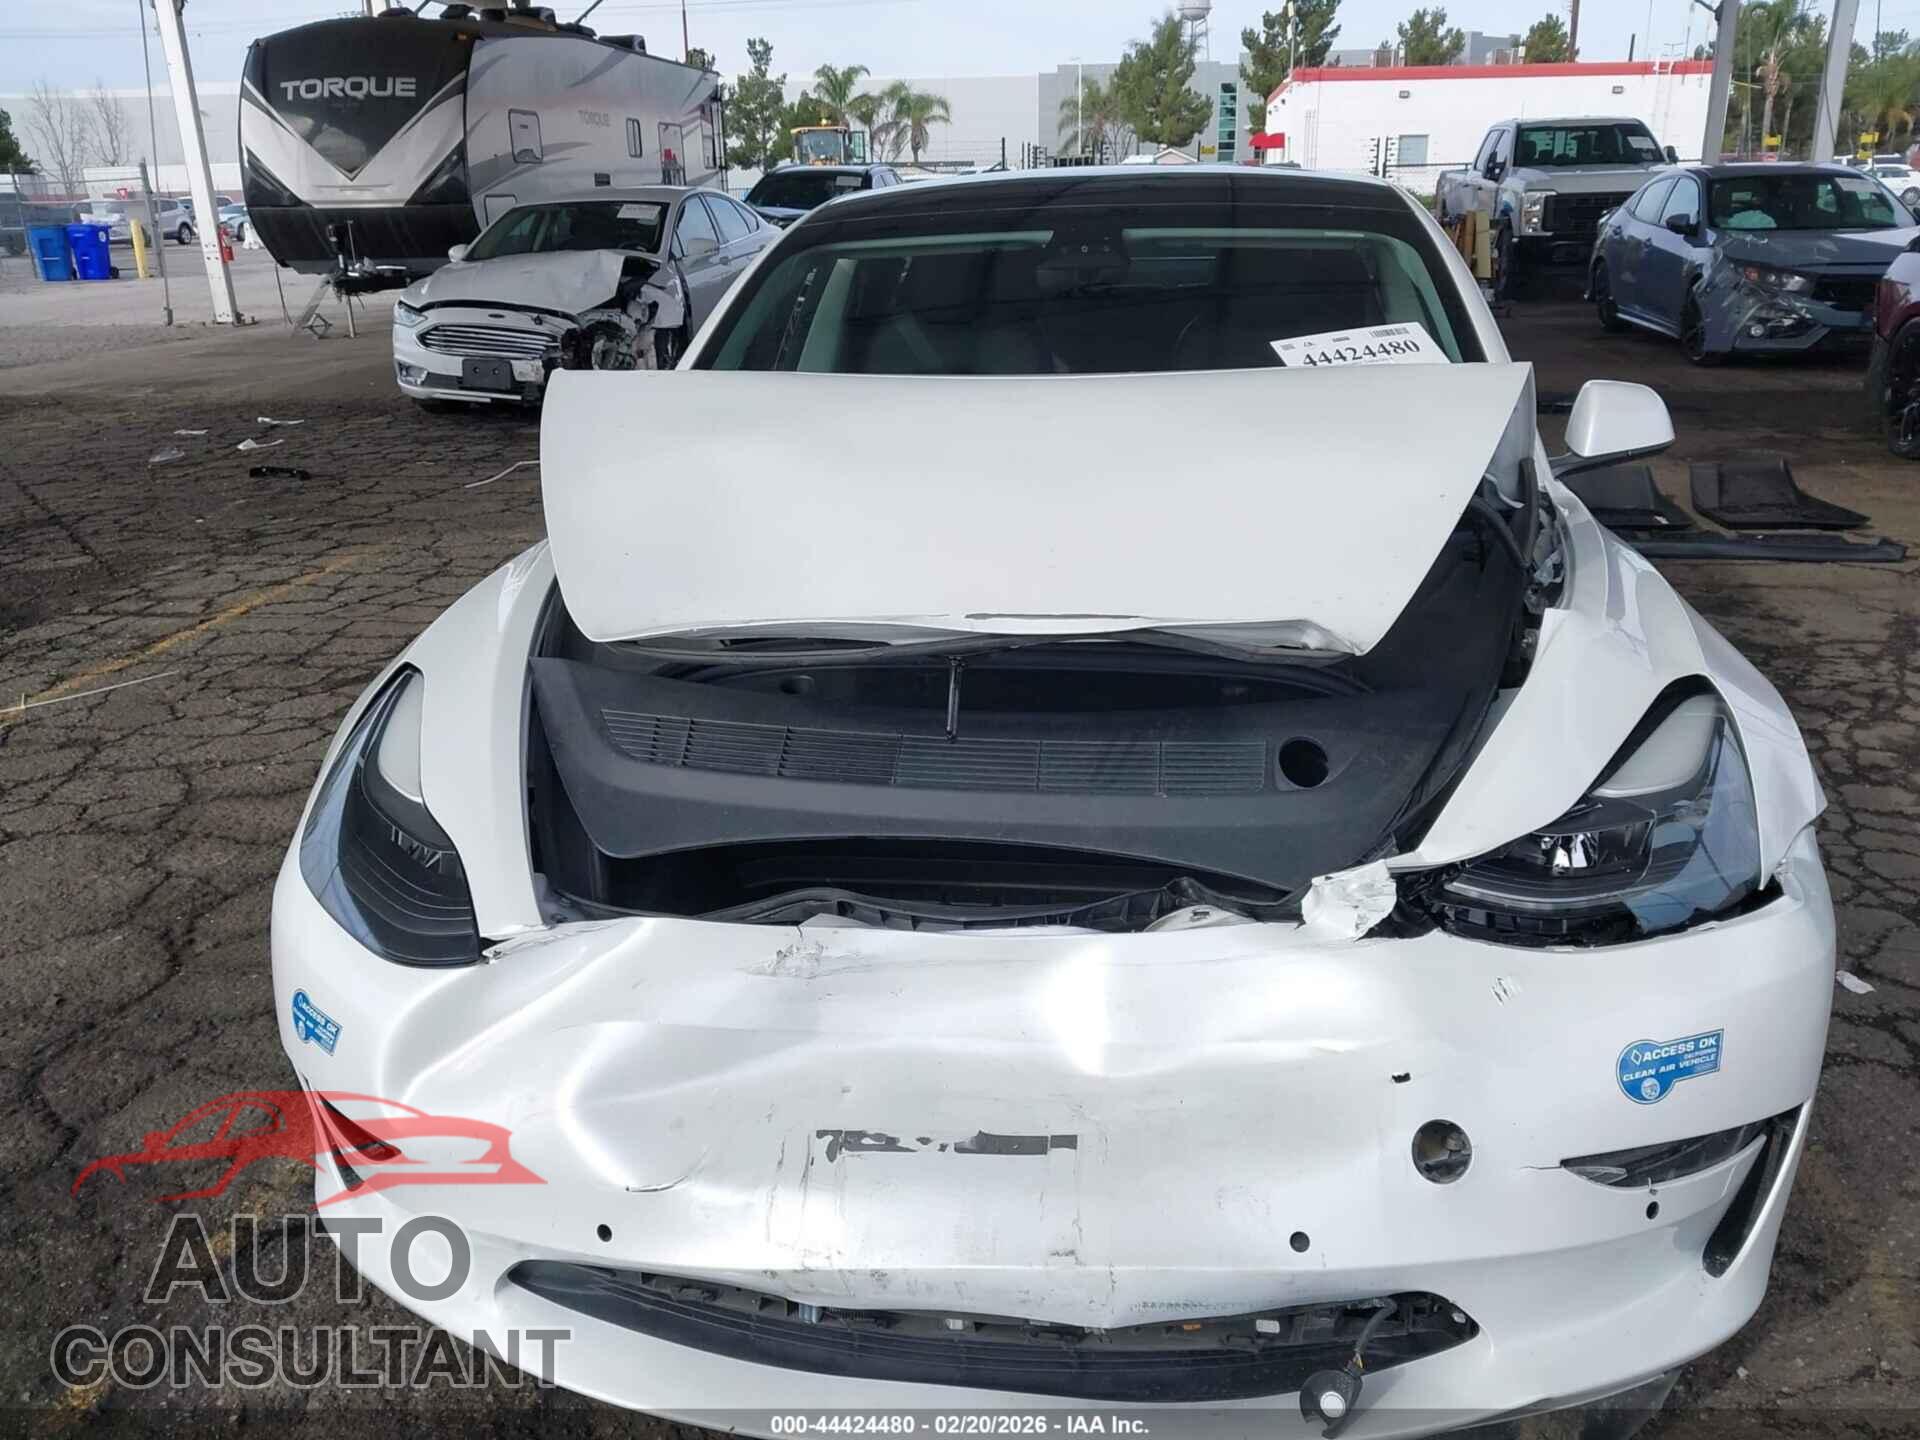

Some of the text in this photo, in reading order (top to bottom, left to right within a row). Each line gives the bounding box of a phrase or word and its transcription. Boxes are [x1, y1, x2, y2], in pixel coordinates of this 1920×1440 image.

[280, 77, 417, 101] TORQUE
[578, 110, 611, 127] TORQUE
[1303, 339, 1421, 366] 44424480
[326, 1022, 338, 1035] OK
[1643, 1041, 1695, 1062] ACCESS
[1699, 1036, 1718, 1049] OK
[1623, 1067, 1657, 1082] CLEAN
[1659, 1064, 1676, 1074] AIR
[1679, 1053, 1717, 1069] VEHICLE
